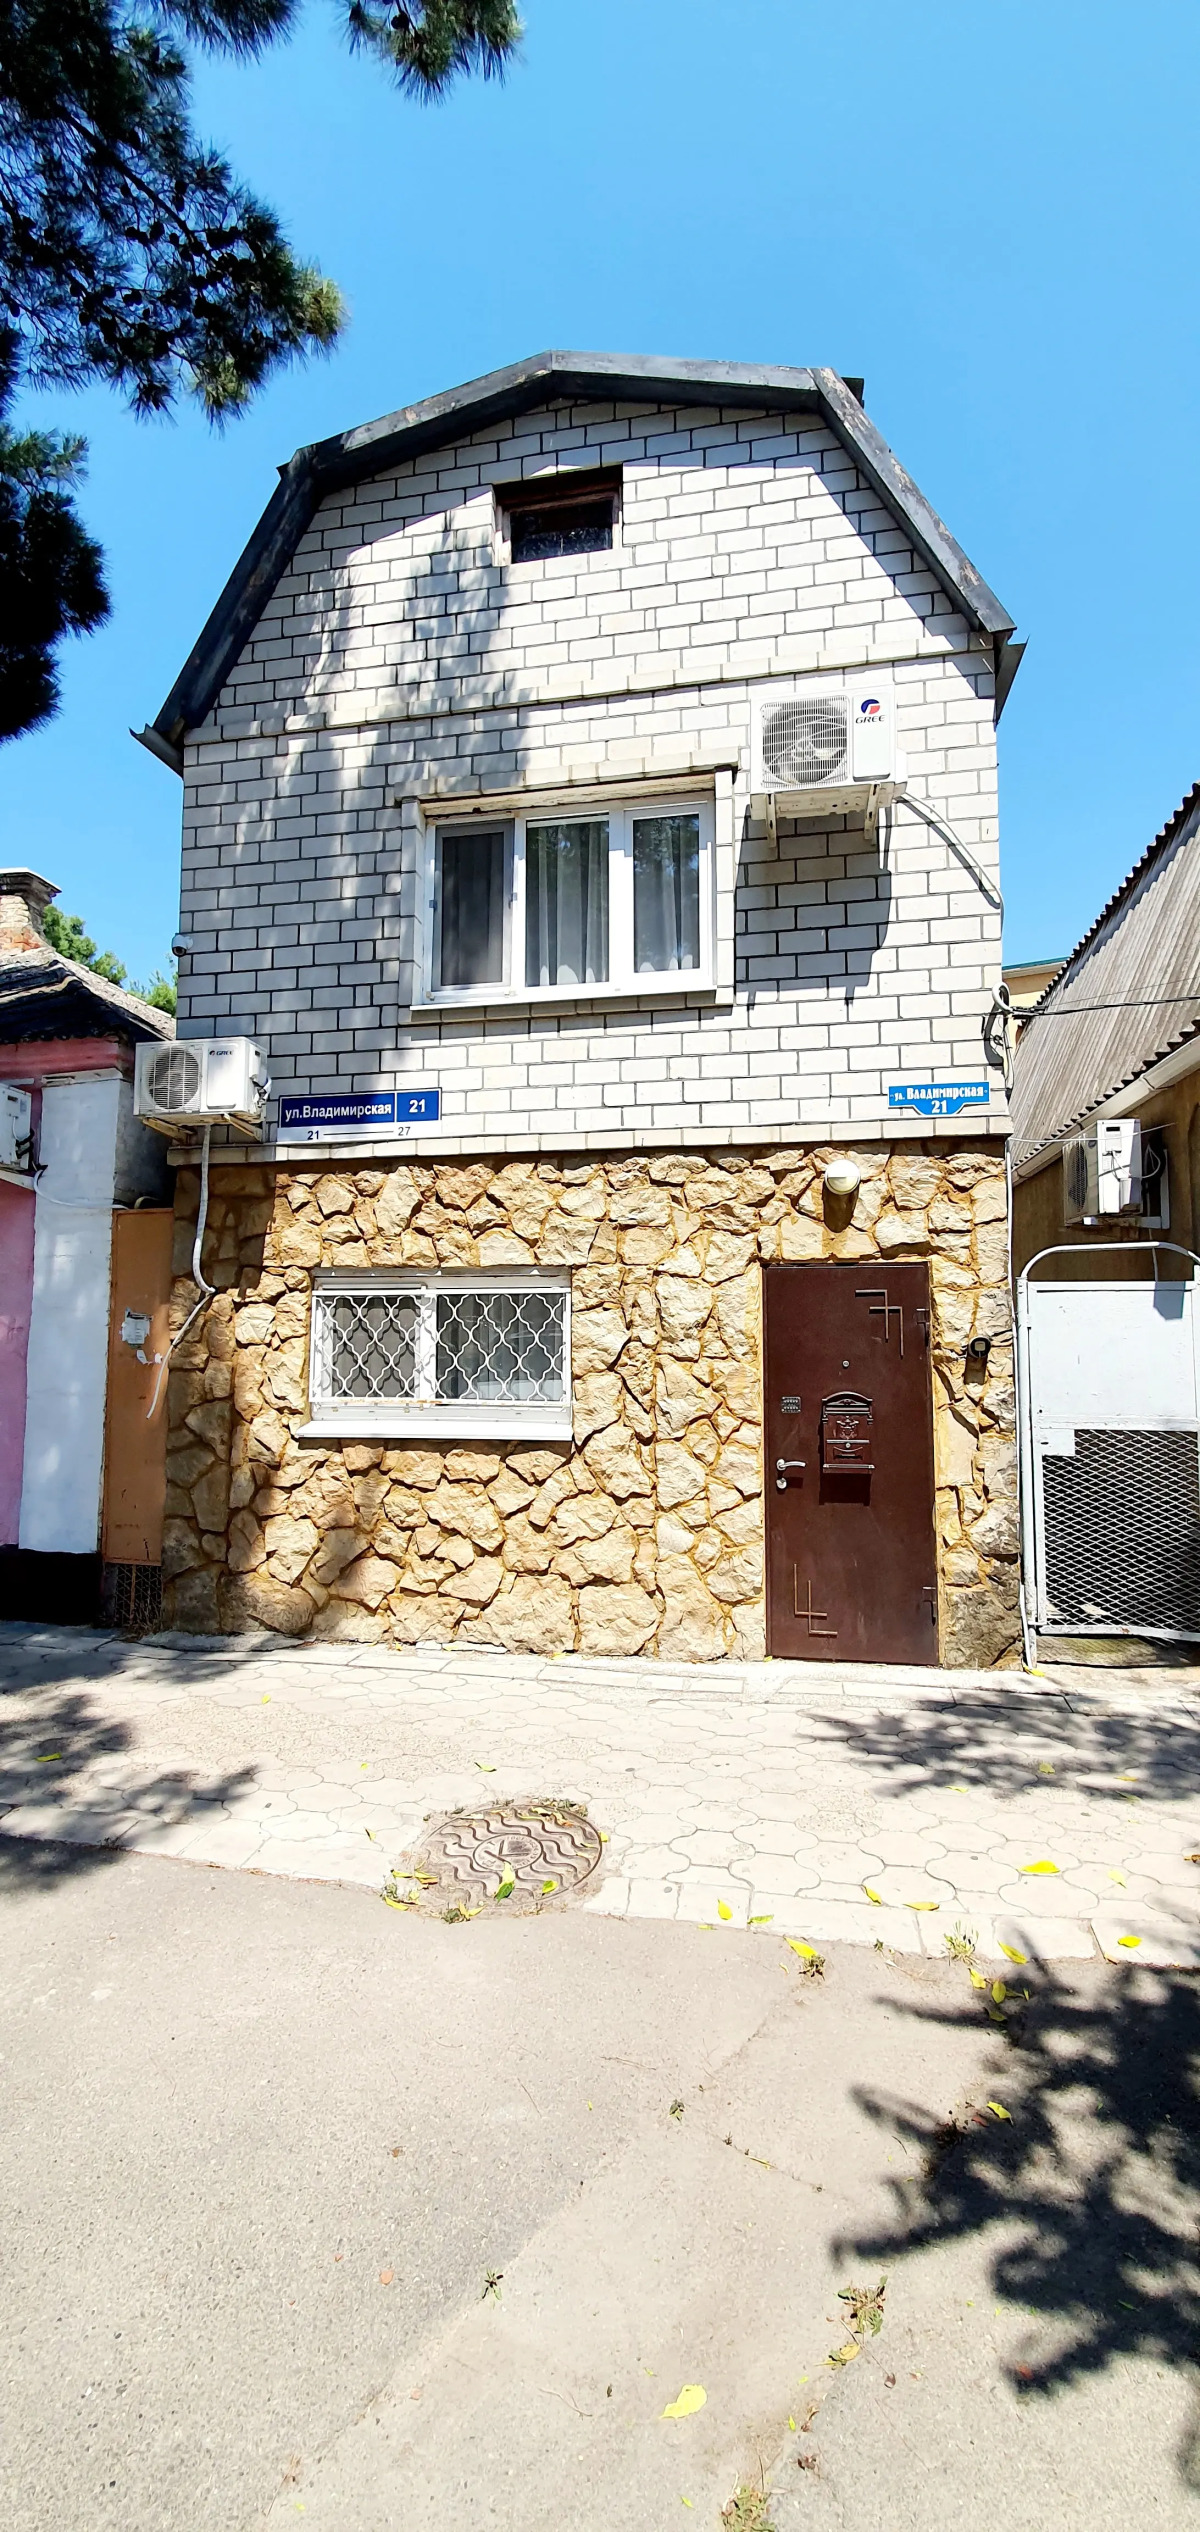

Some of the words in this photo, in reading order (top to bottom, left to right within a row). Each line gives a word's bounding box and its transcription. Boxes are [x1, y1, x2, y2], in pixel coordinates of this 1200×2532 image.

[855, 714, 886, 724] GREE
[906, 1086, 984, 1100] Владимирская
[408, 1099, 426, 1113] 21
[931, 1100, 948, 1114] 21
[307, 1130, 320, 1140] 21
[398, 1126, 411, 1136] 27
